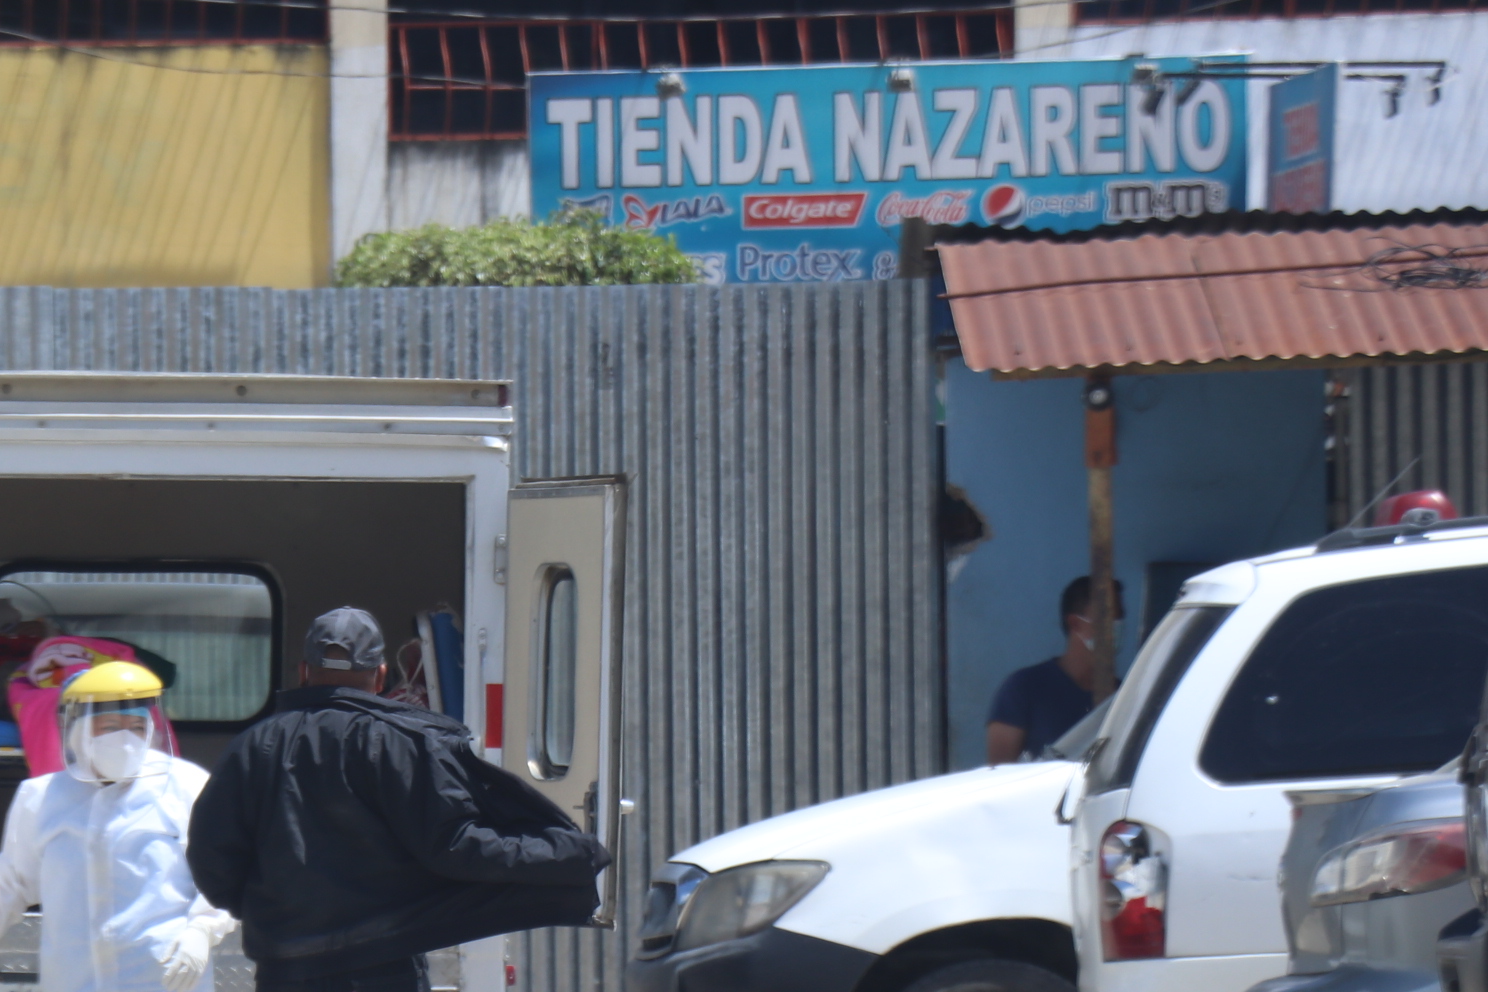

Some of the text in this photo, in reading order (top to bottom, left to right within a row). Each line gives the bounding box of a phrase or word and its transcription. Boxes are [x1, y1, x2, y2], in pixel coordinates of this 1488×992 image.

[546, 94, 812, 189] TIENDA
[833, 80, 1230, 182] NAZARENO
[748, 199, 853, 224] Colgate
[1025, 189, 1096, 217] pepsi
[738, 244, 856, 280] Protex
